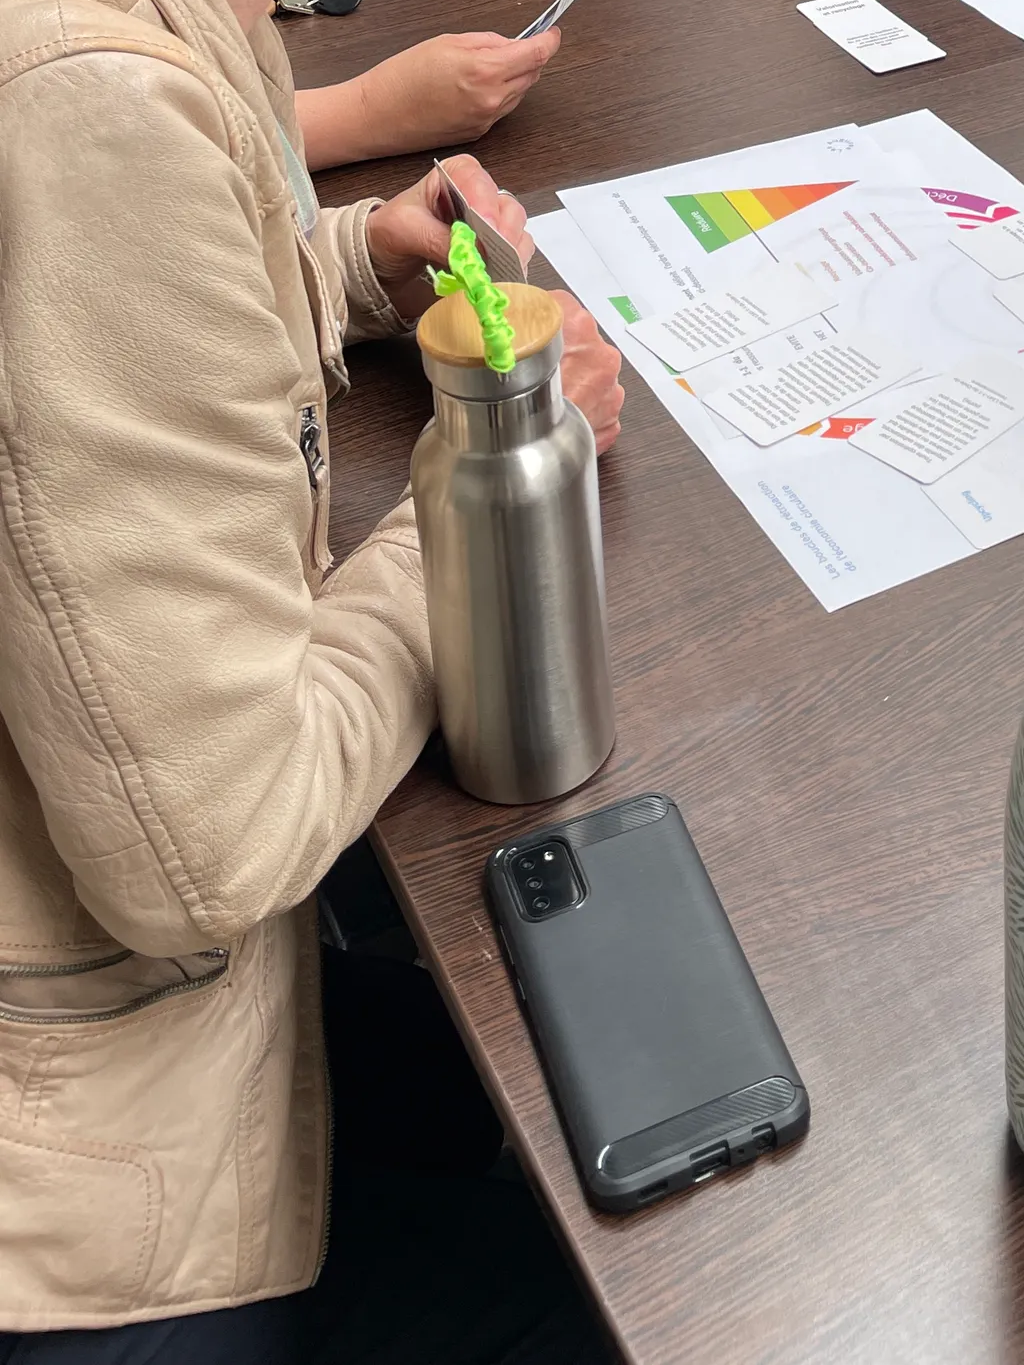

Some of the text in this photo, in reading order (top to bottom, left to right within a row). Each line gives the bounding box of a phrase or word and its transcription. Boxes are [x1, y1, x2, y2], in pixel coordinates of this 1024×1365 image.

[816, 0, 860, 12] Valorisation
[831, 3, 866, 15] recyclage
[958, 489, 994, 521] Upcycling
[755, 480, 840, 579] Les boucles de rétroaction
[779, 484, 856, 572] de l'économie circulaire
